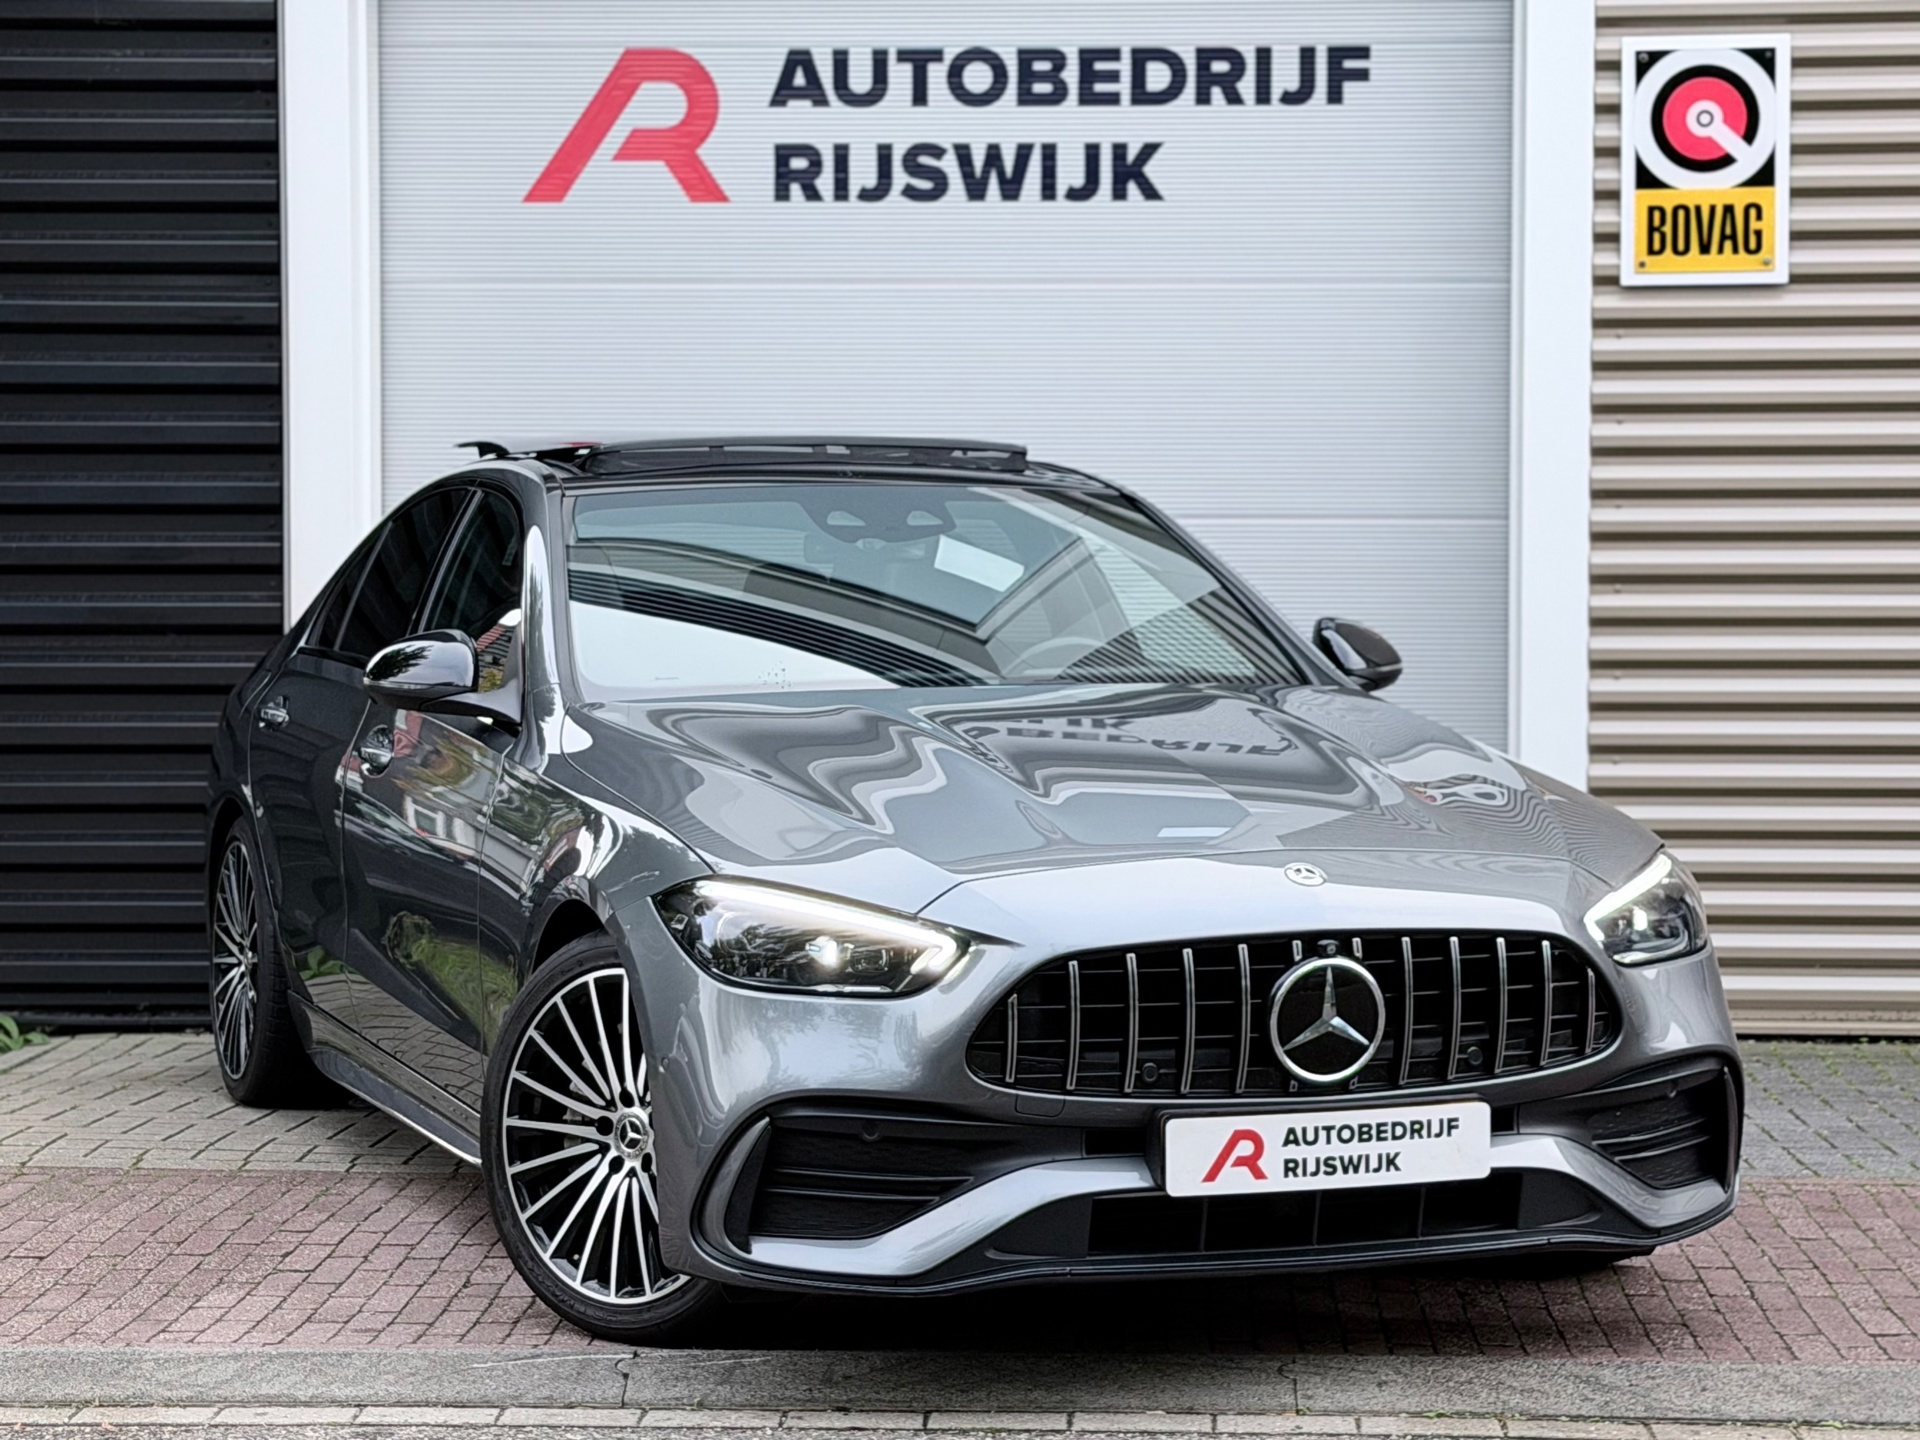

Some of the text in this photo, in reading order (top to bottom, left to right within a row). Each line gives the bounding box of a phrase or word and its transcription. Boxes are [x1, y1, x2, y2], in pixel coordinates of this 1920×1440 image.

[769, 46, 1371, 108] AUTOBEDRIJF
[774, 143, 1164, 203] RIJSWIJK
[1647, 202, 1763, 257] BOVAG
[1281, 1117, 1460, 1148] AUTOBEDRIJF
[1283, 1152, 1402, 1179] RIJSWIJK
